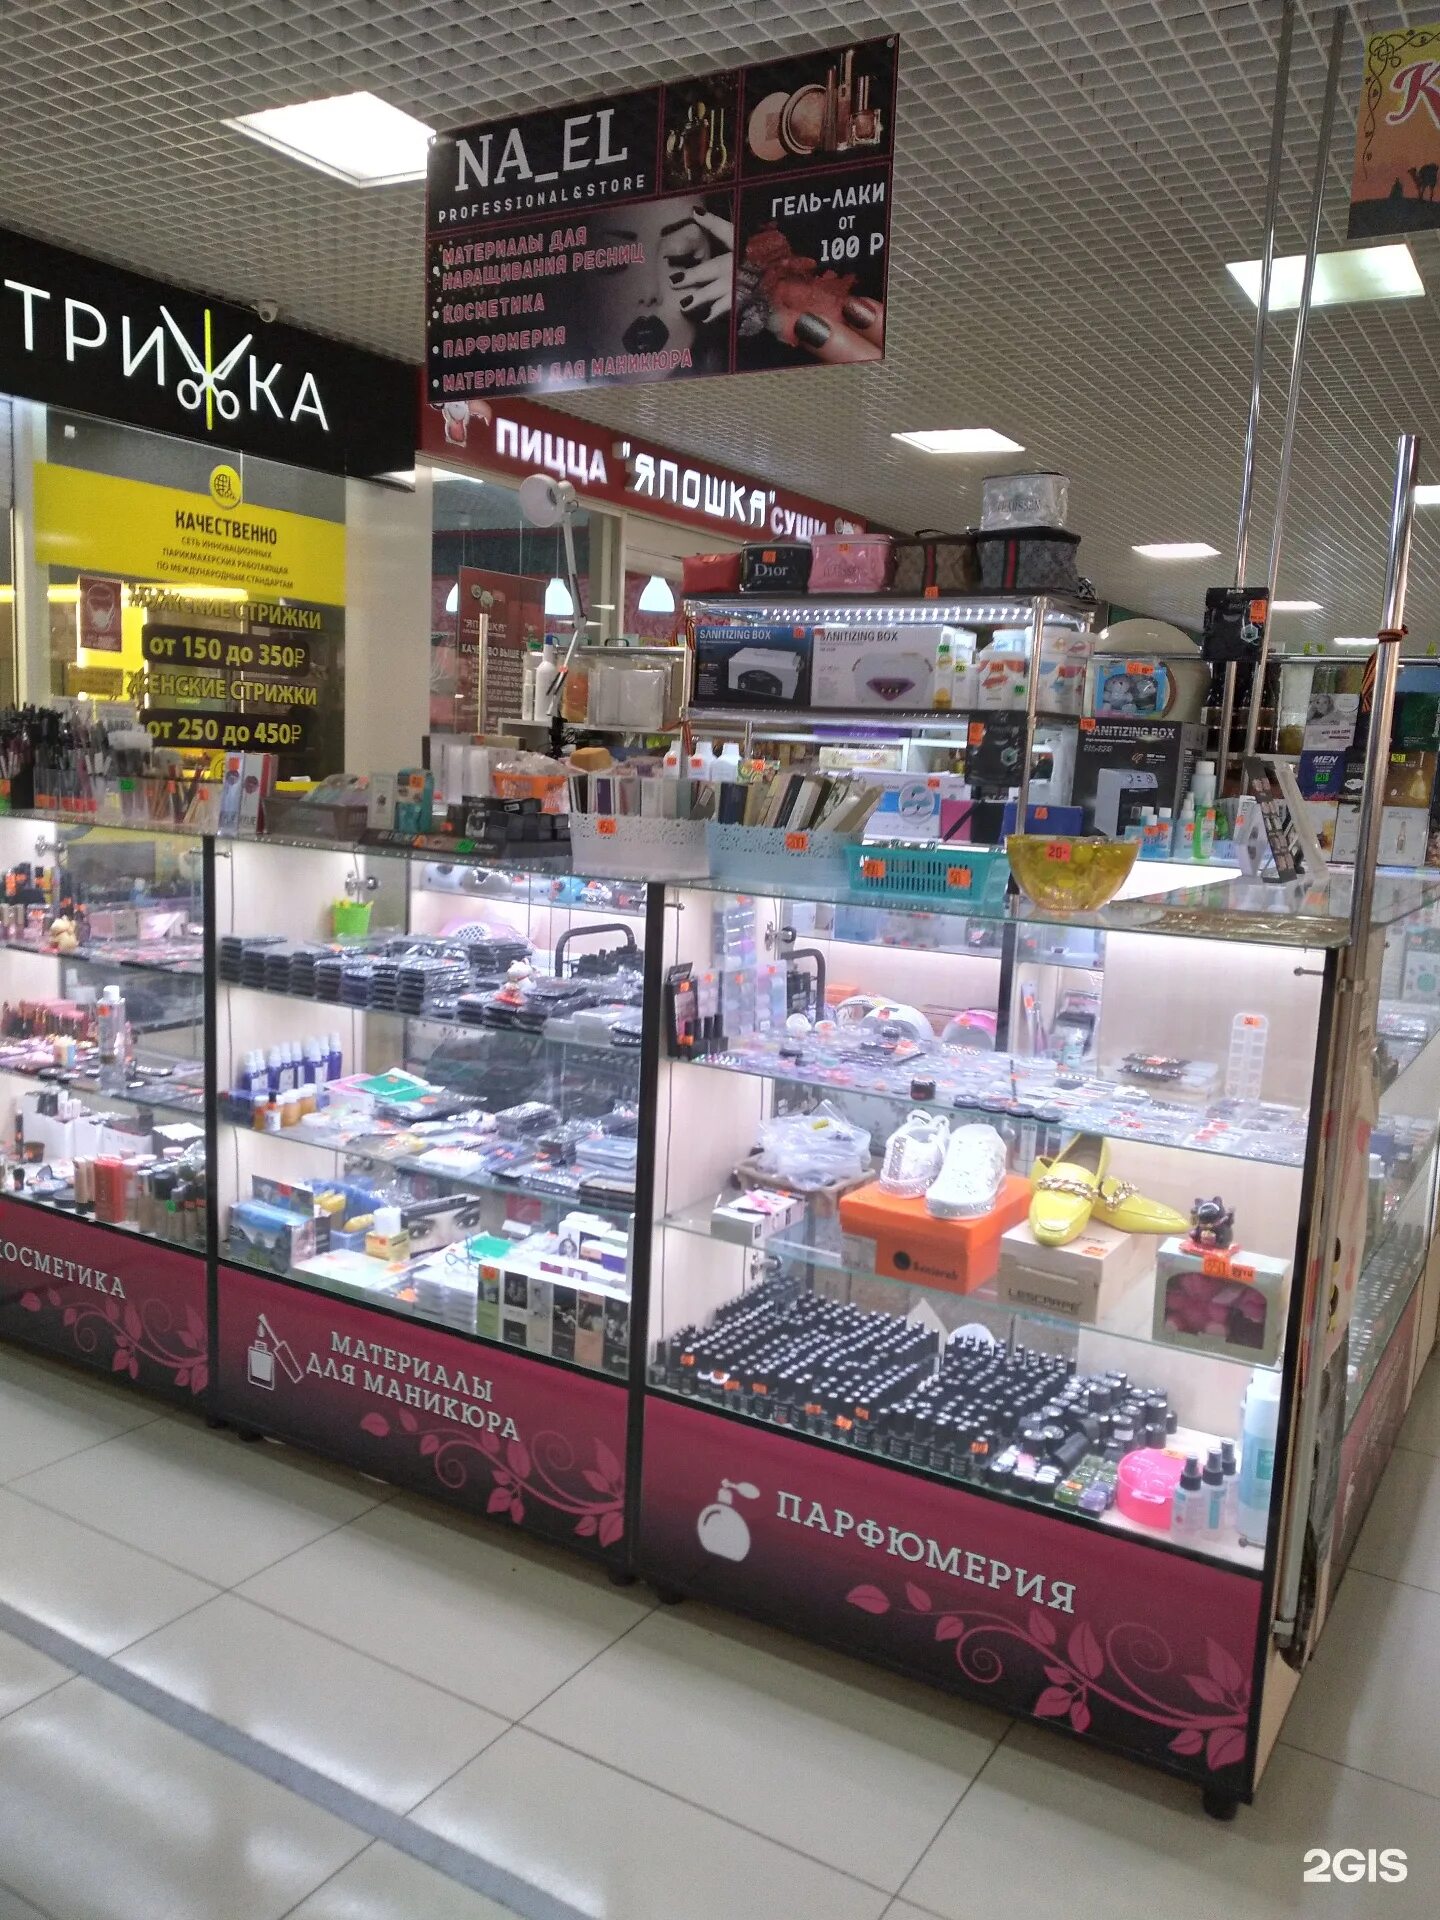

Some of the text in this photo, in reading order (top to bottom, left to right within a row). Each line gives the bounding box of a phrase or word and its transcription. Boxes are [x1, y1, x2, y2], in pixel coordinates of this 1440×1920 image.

[455, 109, 628, 192] NA_EL
[772, 182, 885, 218] ГЕЛЬ-ЛАКИ
[838, 215, 856, 230] ОТ
[442, 226, 587, 266] МАТЕРИАЛЫ ДЛЯ
[820, 235, 860, 262] 100
[442, 242, 646, 291] НАРАЩИВАНИЯ РЕСНИЦ
[443, 293, 545, 324] КОСМЕТИКА
[442, 325, 566, 359] ПАРФЮМЕРИЯ
[442, 347, 693, 393] МАТЕРИАЛЫ ДЛЯ МАНИКЮРА
[496, 416, 609, 486] ПИЦЦА
[175, 509, 278, 545] КАЧЕСТВЕННО
[181, 536, 201, 547] СЕТЬ
[156, 560, 169, 571] ПО
[754, 563, 789, 577] Dior
[235, 600, 322, 630] СТРИЖКИ
[699, 629, 771, 640] SANITIZING BOX
[876, 631, 898, 642] BOX
[149, 637, 177, 656] от
[182, 635, 222, 660] 150
[225, 644, 253, 666] до
[230, 679, 318, 706] СТРИЖКИ
[147, 721, 173, 739] от
[177, 717, 218, 741] 250
[222, 724, 250, 746] до
[1151, 727, 1175, 739] BOX
[1312, 755, 1339, 765] MEN
[330, 1331, 494, 1403] МАТЕРИАЛЫ
[306, 1352, 521, 1443] ДЛЯ МАНИКЮРА
[775, 1490, 1077, 1615] ПАРФЮМЕРИЯ
